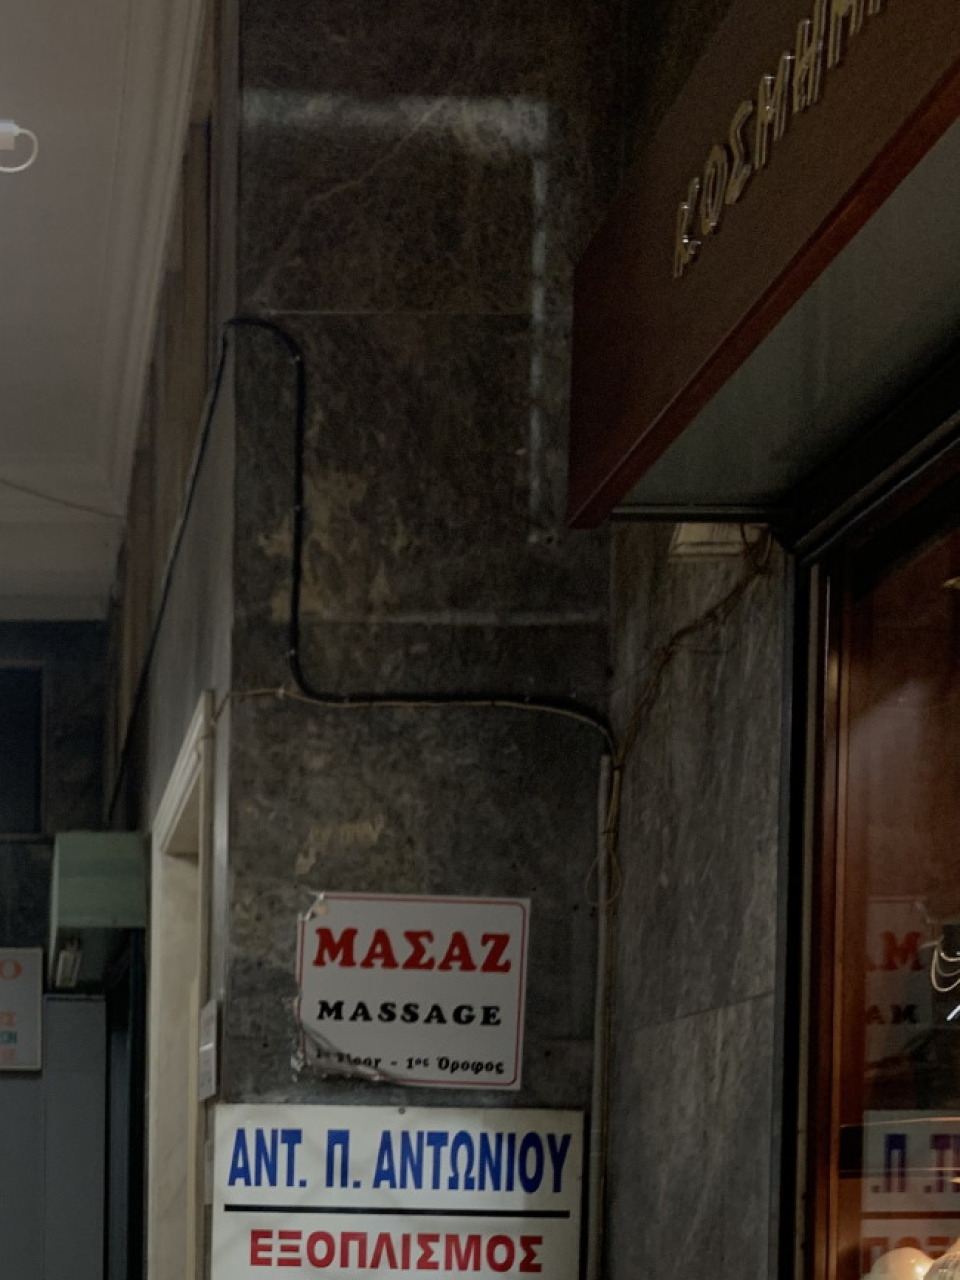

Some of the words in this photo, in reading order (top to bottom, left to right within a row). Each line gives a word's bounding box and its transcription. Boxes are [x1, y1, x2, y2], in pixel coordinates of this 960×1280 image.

[673, 0, 881, 279] ΚΟΣΜΗΜ
[312, 927, 512, 973] ΜΑΣΑΖ
[316, 1001, 502, 1026] MASSAGE
[227, 1128, 307, 1188] ΑΝΤ.
[325, 1129, 361, 1189] Π.
[372, 1130, 572, 1194] ΑΝΤΩΝΙΟΥ
[249, 1229, 544, 1273] ΕΞΟΠΛΙΣΜΟΣ
